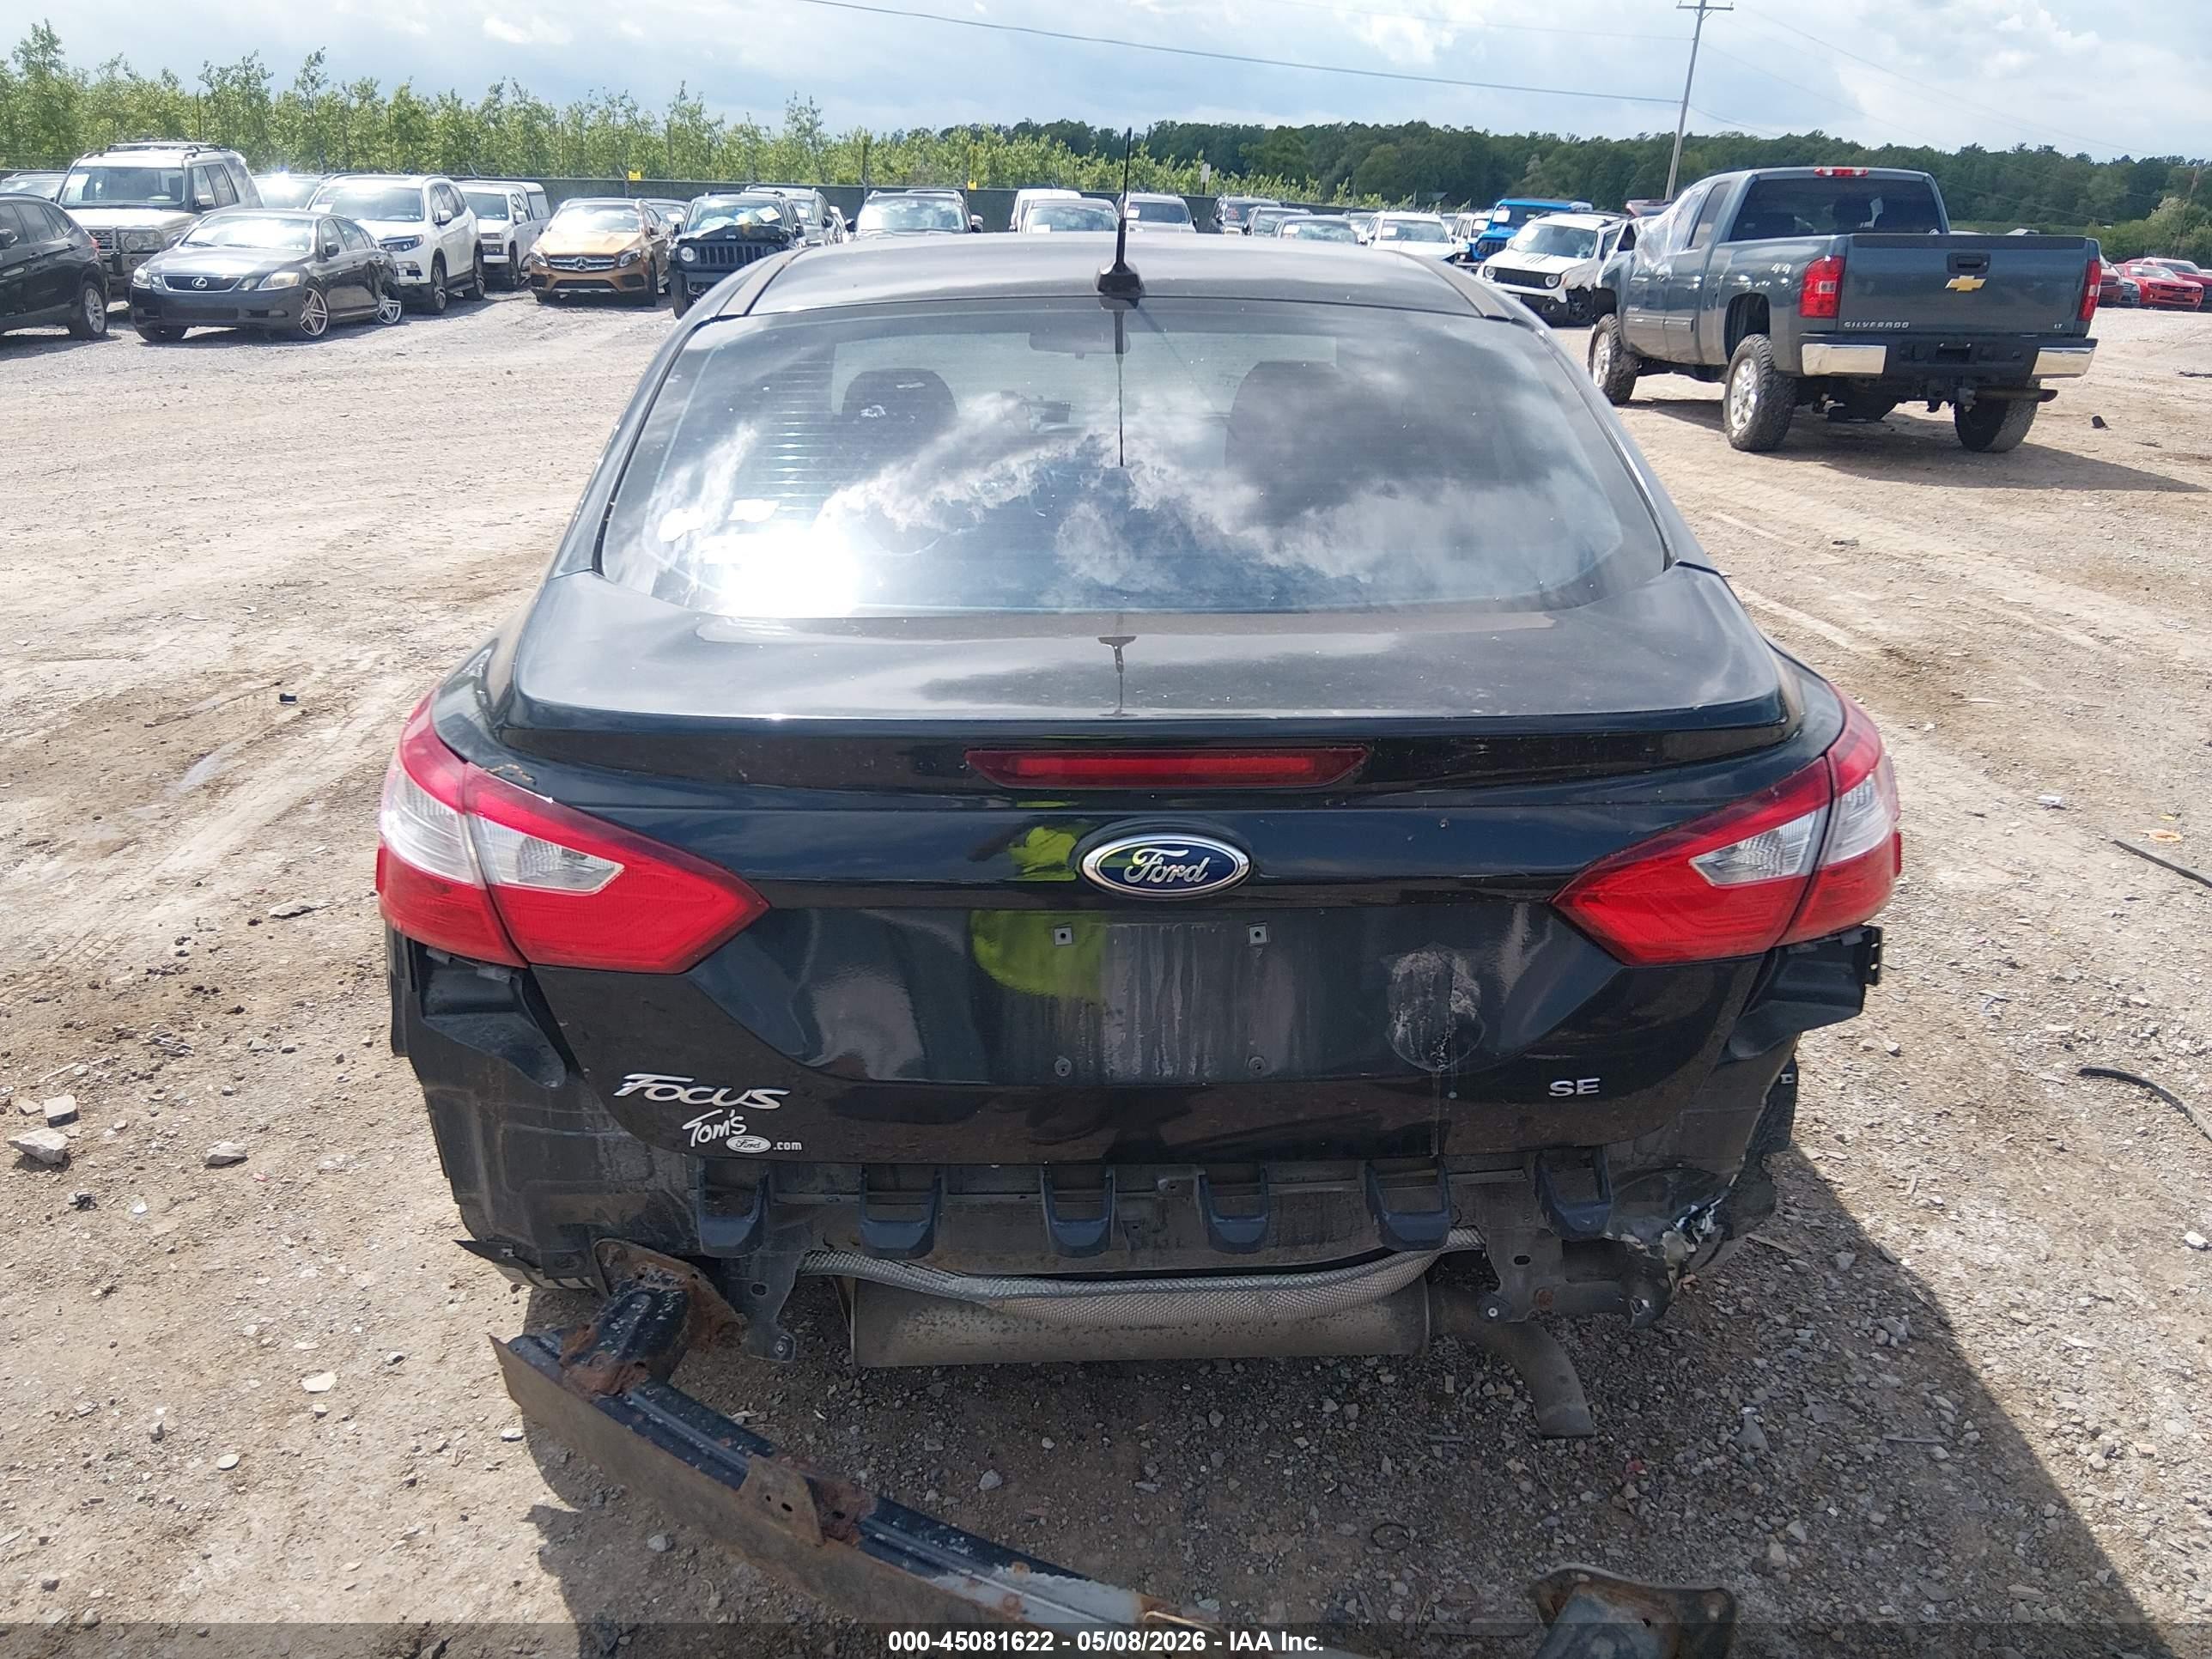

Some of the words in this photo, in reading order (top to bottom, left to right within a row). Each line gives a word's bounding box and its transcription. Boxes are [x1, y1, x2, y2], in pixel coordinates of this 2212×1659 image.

[1123, 848, 1211, 884] Ford
[1548, 1078, 1601, 1097] SE
[682, 1109, 747, 1147] Tom's
[735, 1139, 762, 1149] Ford
[773, 1141, 802, 1151] .com
